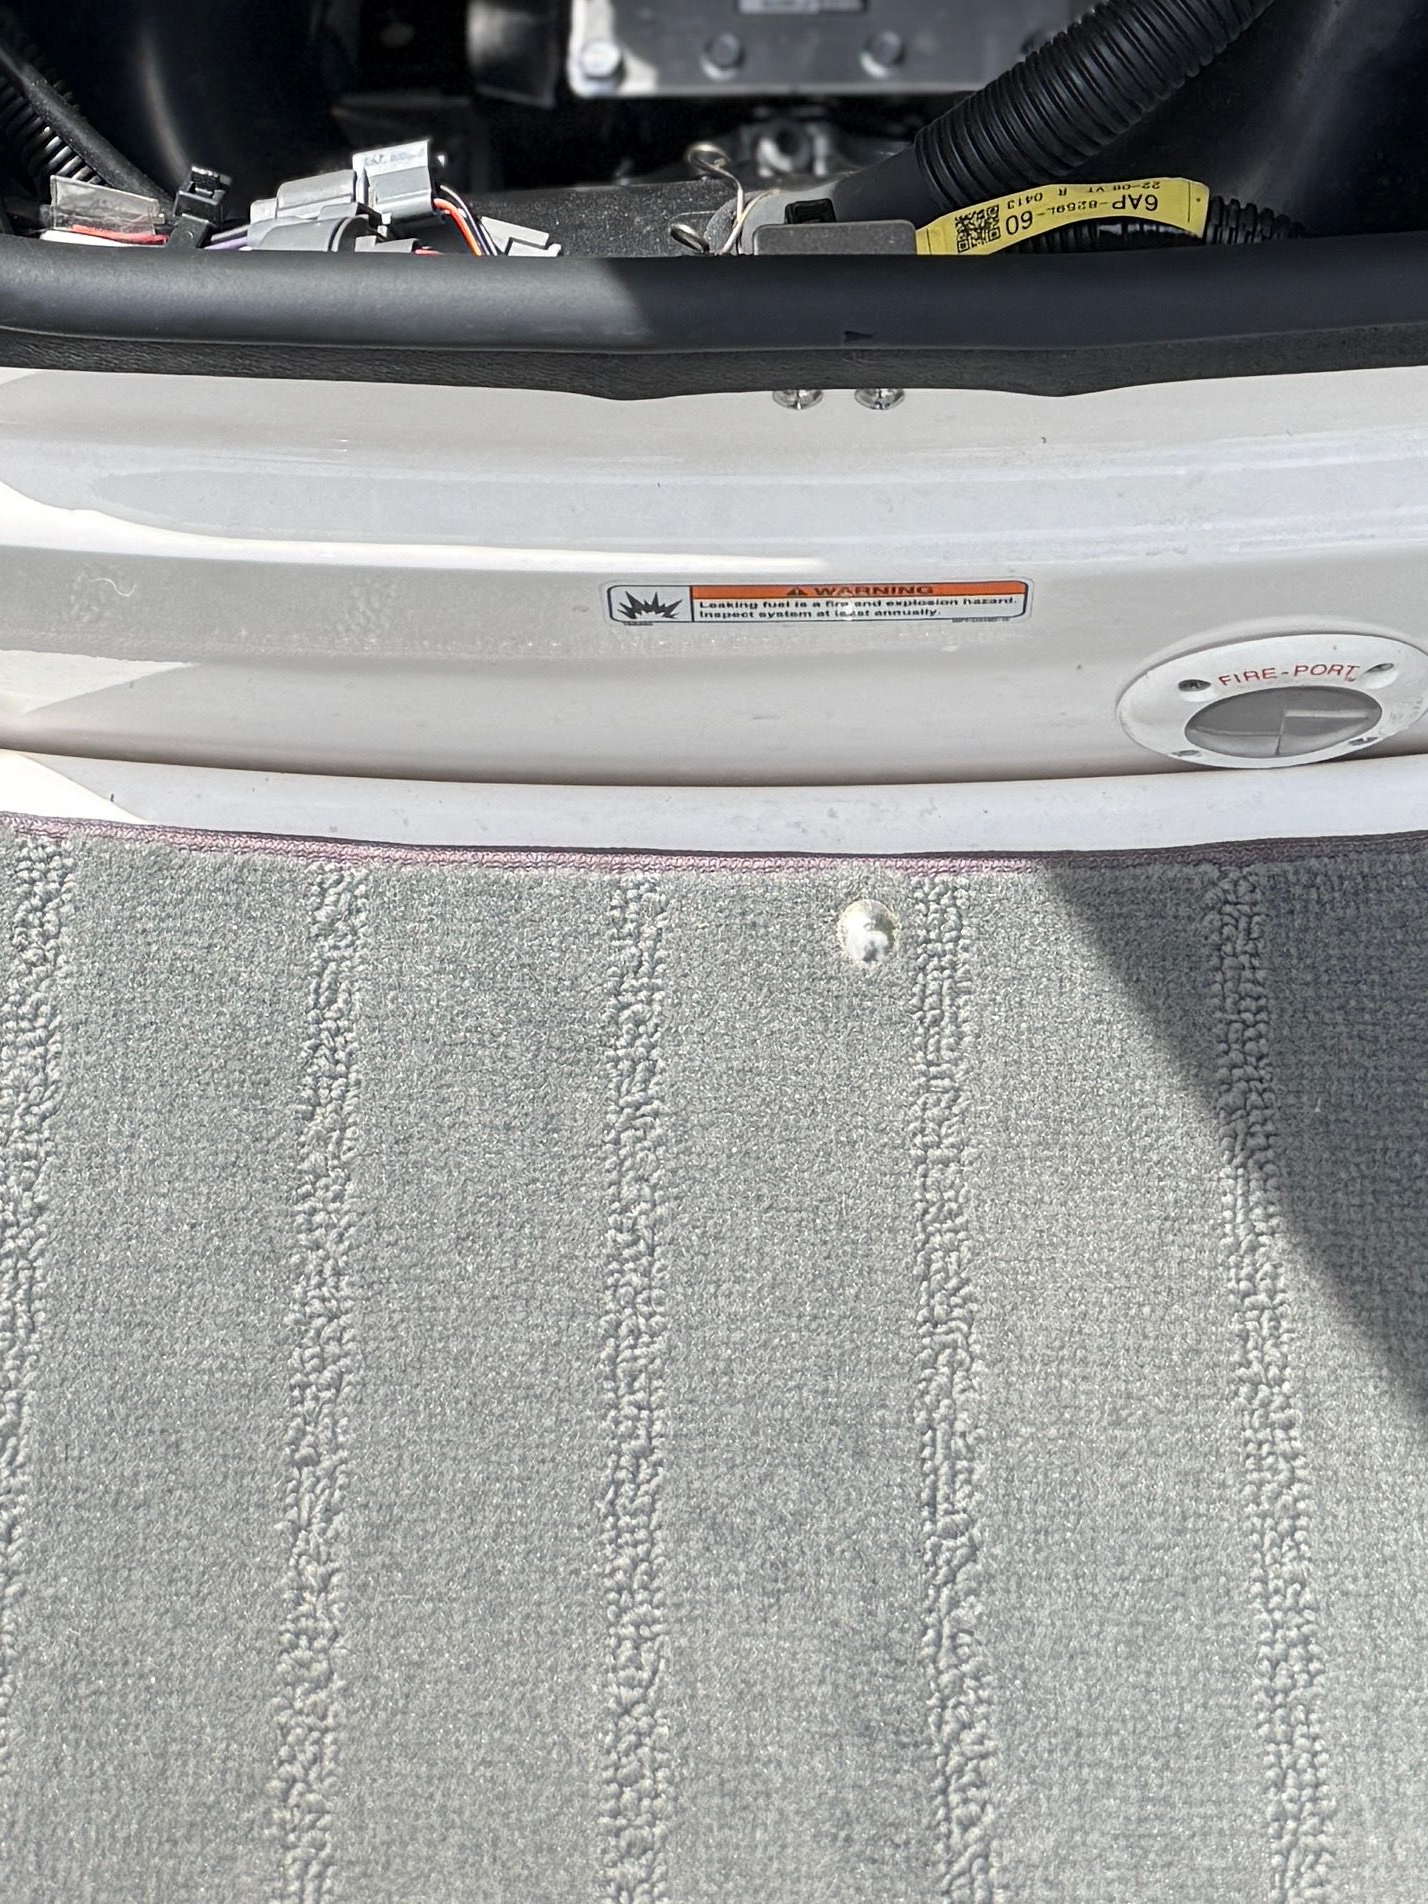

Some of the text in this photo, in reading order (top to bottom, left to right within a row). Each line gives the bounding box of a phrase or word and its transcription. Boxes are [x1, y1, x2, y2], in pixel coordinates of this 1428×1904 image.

[813, 586, 934, 596] WARNING
[699, 601, 759, 610] Leaking
[762, 600, 790, 609] fuel
[825, 599, 849, 608] fire
[854, 599, 882, 608] and
[885, 597, 959, 608] explosion
[963, 596, 1018, 606] hazard.
[699, 610, 754, 620] Inspect
[758, 610, 812, 620] system
[816, 610, 830, 618] at
[874, 607, 941, 617] annually.
[1217, 663, 1361, 686] FIRE-PORT
